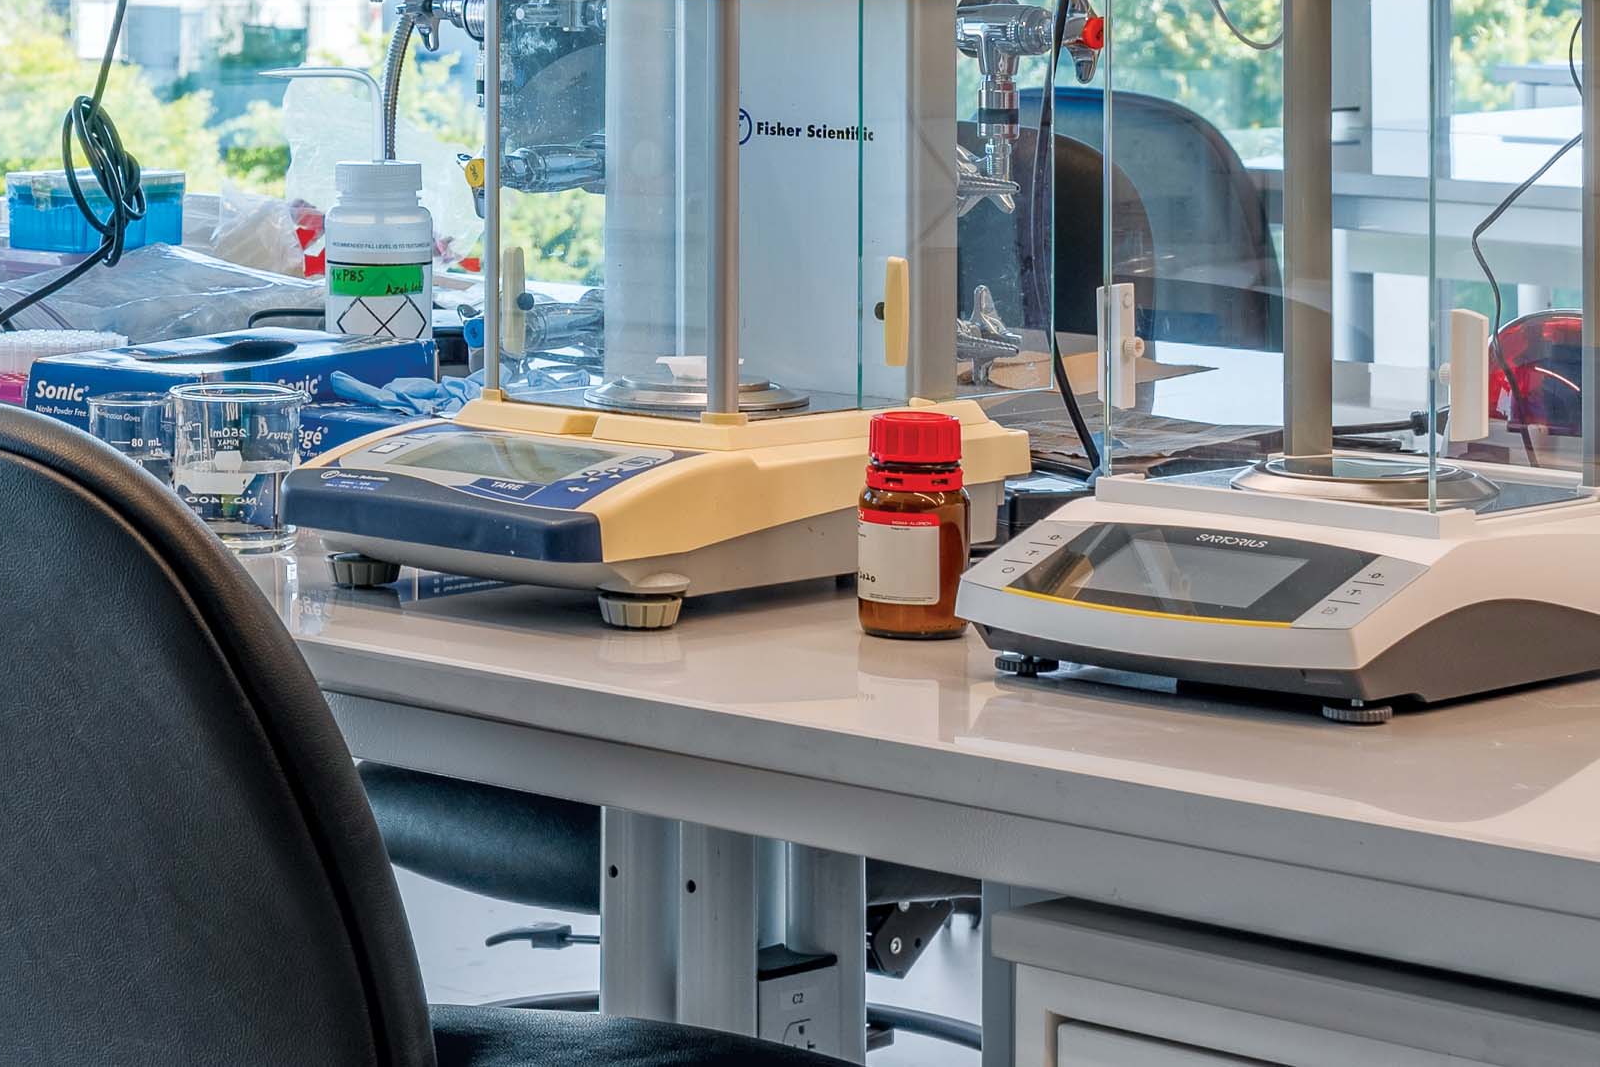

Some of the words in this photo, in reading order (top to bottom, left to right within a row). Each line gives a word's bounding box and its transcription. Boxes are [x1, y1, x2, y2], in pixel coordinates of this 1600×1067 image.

[756, 122, 802, 138] Fisher
[807, 124, 874, 142] Scientific
[53, 406, 74, 416] Powder
[74, 408, 87, 417] Free
[131, 438, 143, 447] 80
[148, 438, 162, 447] mL
[490, 480, 523, 492] TARE
[1195, 533, 1269, 549] SARTORIUS
[792, 992, 804, 1004] C2
